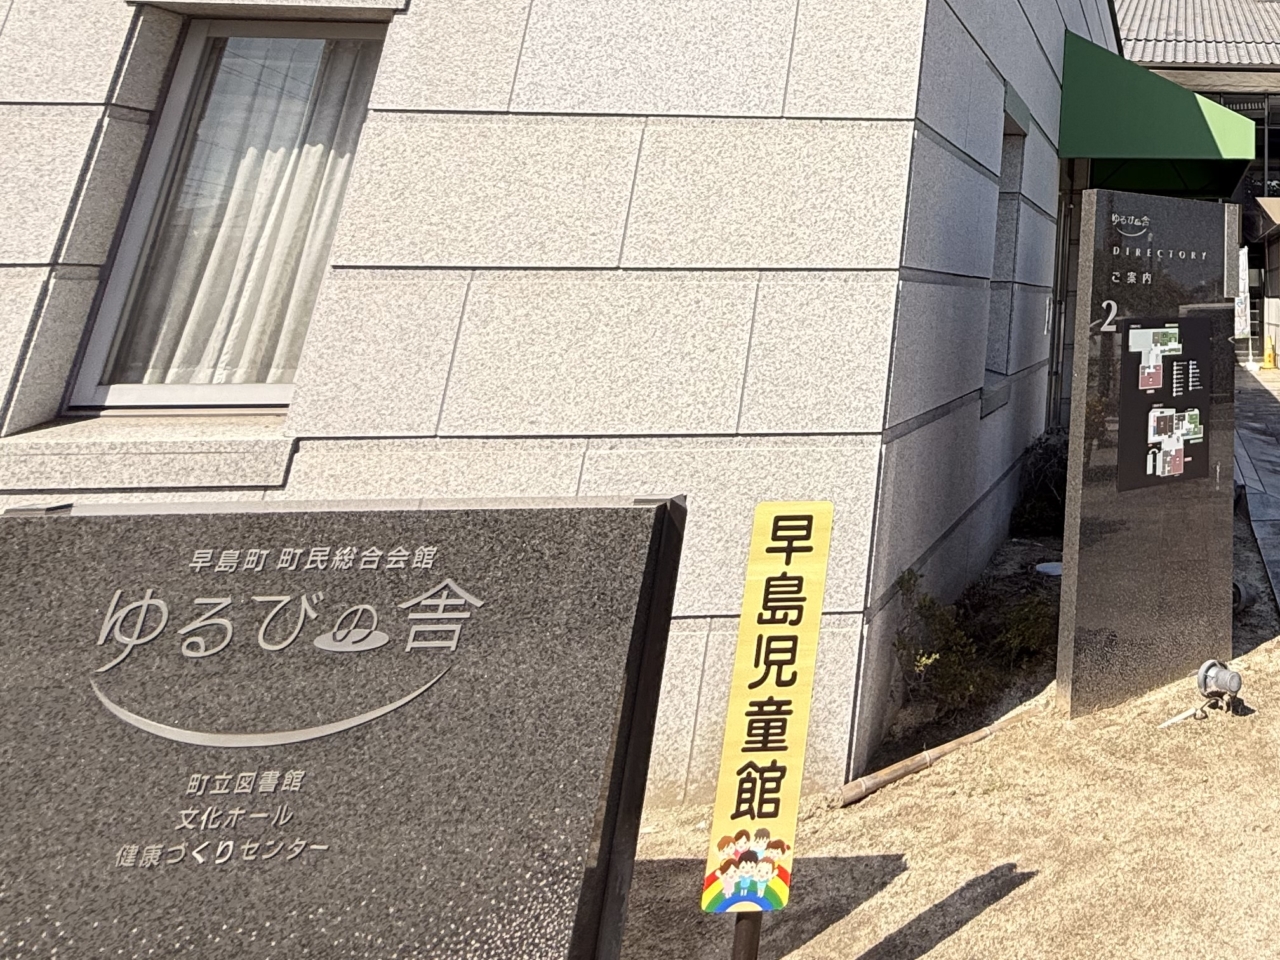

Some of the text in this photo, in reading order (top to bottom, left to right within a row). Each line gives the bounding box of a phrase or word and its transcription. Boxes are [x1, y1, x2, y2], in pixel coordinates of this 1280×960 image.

[1113, 246, 1207, 260] DIRECTORY
[1111, 271, 1152, 284] ご案内
[1100, 299, 1118, 332] 2
[189, 545, 438, 573] 早島町 町民総合会館
[94, 577, 484, 674] ゆるびの舎
[730, 514, 814, 821] 早島児童館
[186, 770, 305, 796] 町立図書館
[175, 804, 294, 832] 文化ホール
[114, 838, 331, 868] 健康づくりセンター
